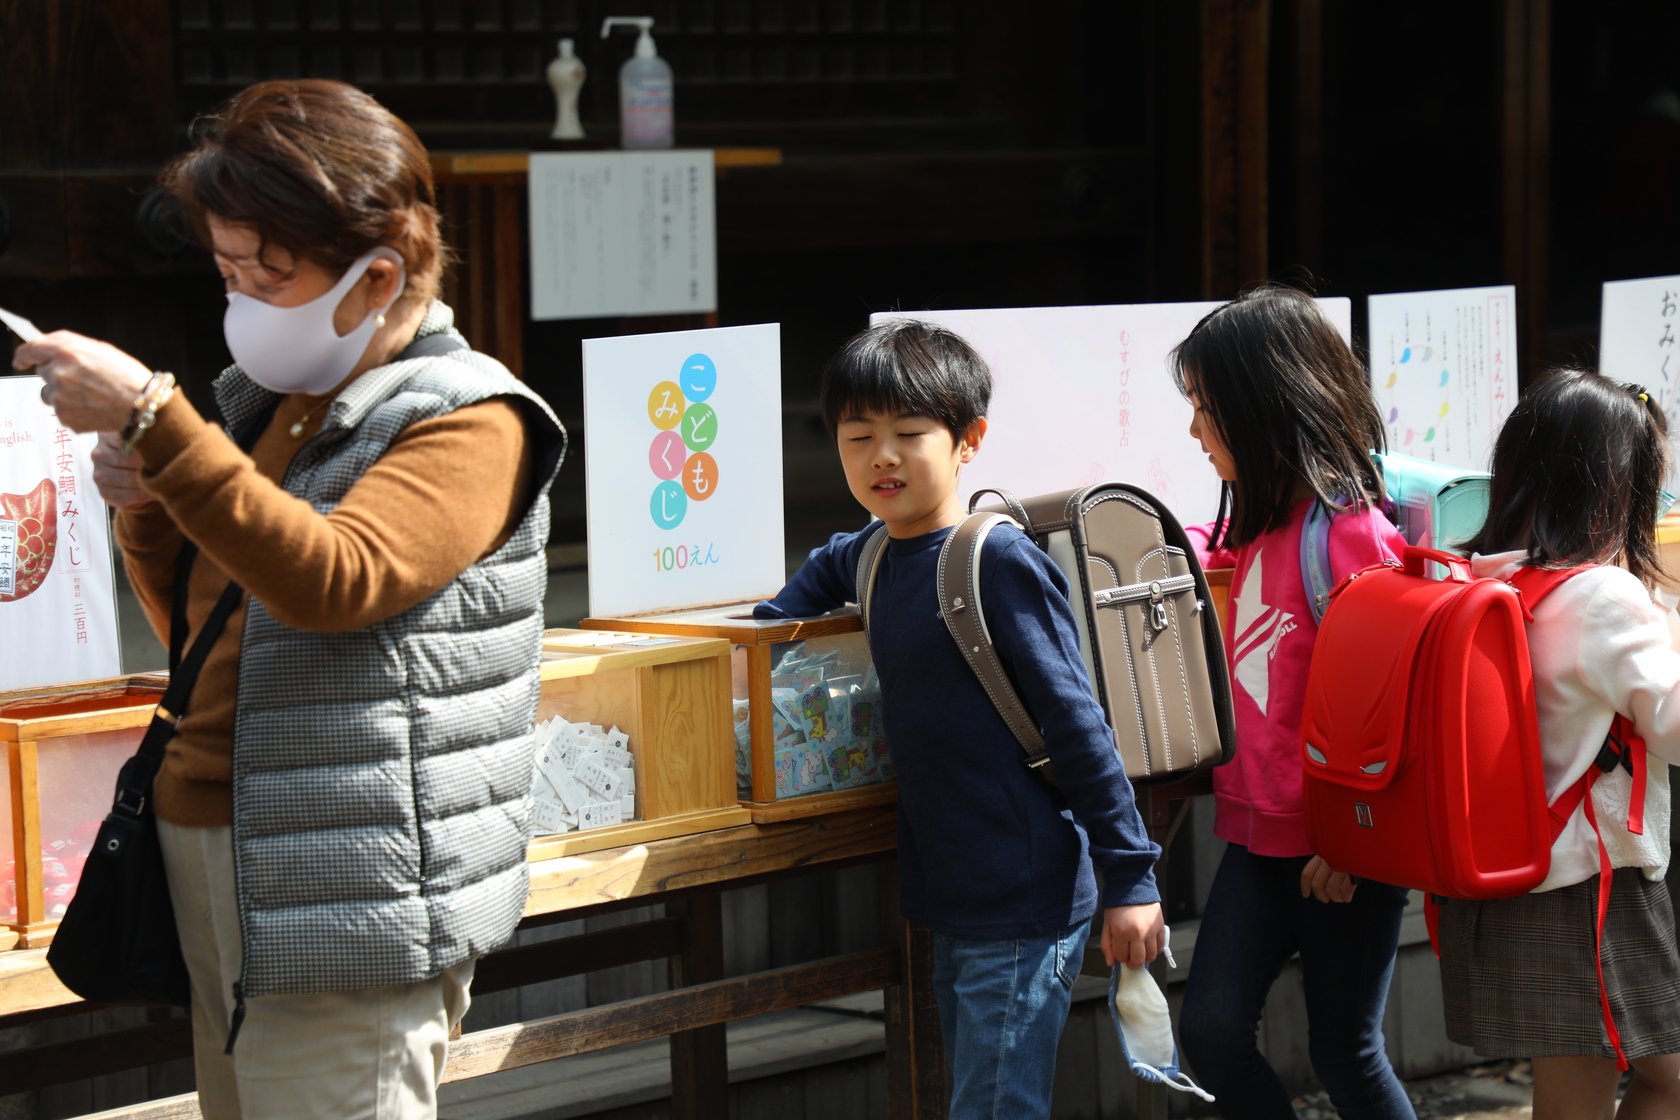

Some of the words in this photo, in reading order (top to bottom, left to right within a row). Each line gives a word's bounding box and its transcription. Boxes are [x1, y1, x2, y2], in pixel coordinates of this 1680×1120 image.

[1659, 289, 1678, 413] おみくじ
[654, 390, 679, 522] みくじ
[690, 364, 713, 494] こども
[652, 542, 720, 573] 100えん
